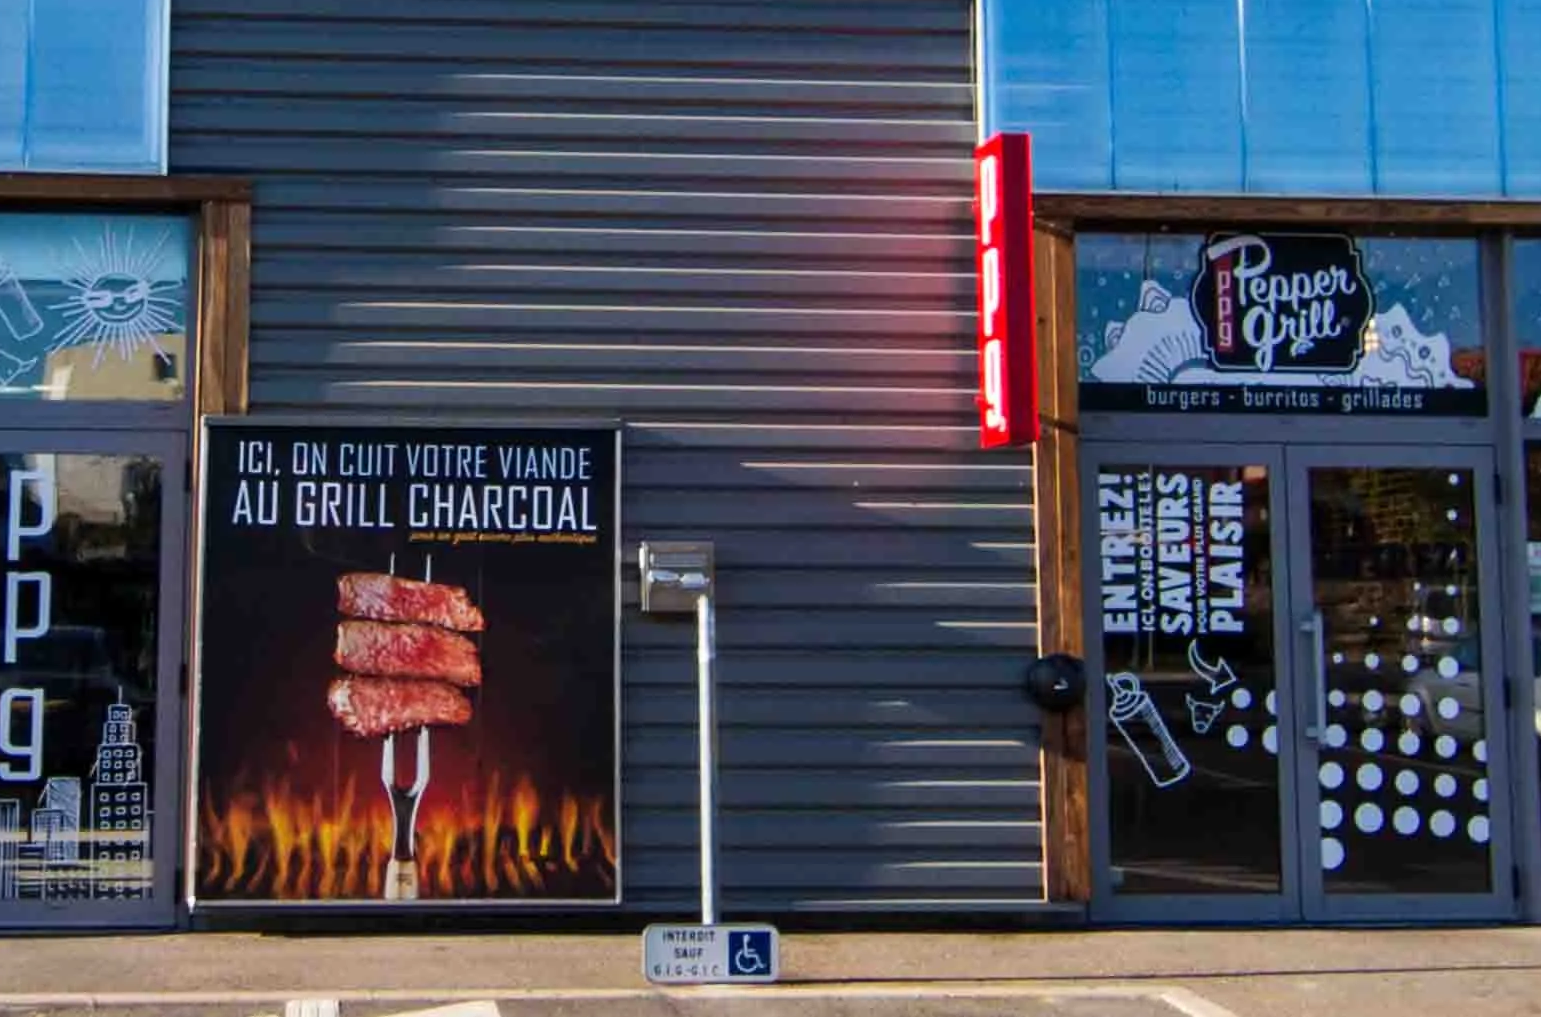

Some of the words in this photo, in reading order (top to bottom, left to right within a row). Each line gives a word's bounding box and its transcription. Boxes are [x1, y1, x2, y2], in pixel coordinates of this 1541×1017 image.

[1206, 235, 1356, 312] Pepper
[1216, 271, 1233, 347] ppg
[1243, 301, 1343, 370] grill
[1146, 386, 1220, 411] burgers
[1243, 387, 1320, 408] burritos
[1341, 388, 1424, 412] grillades
[238, 440, 281, 476] ICI,
[292, 441, 327, 476] ON
[339, 442, 399, 478] CUIT
[406, 444, 488, 480] VOTRE
[499, 447, 592, 481] VIANDE
[231, 479, 279, 526] AU
[295, 482, 395, 528] GRILL
[409, 485, 597, 531] CHARCOAL
[1099, 473, 1138, 633] ENTREZ!
[1157, 472, 1194, 636] SAVEURS
[1209, 481, 1245, 633] PLAISIR
[662, 930, 715, 944] INTERDIT
[674, 947, 704, 959] SAUF
